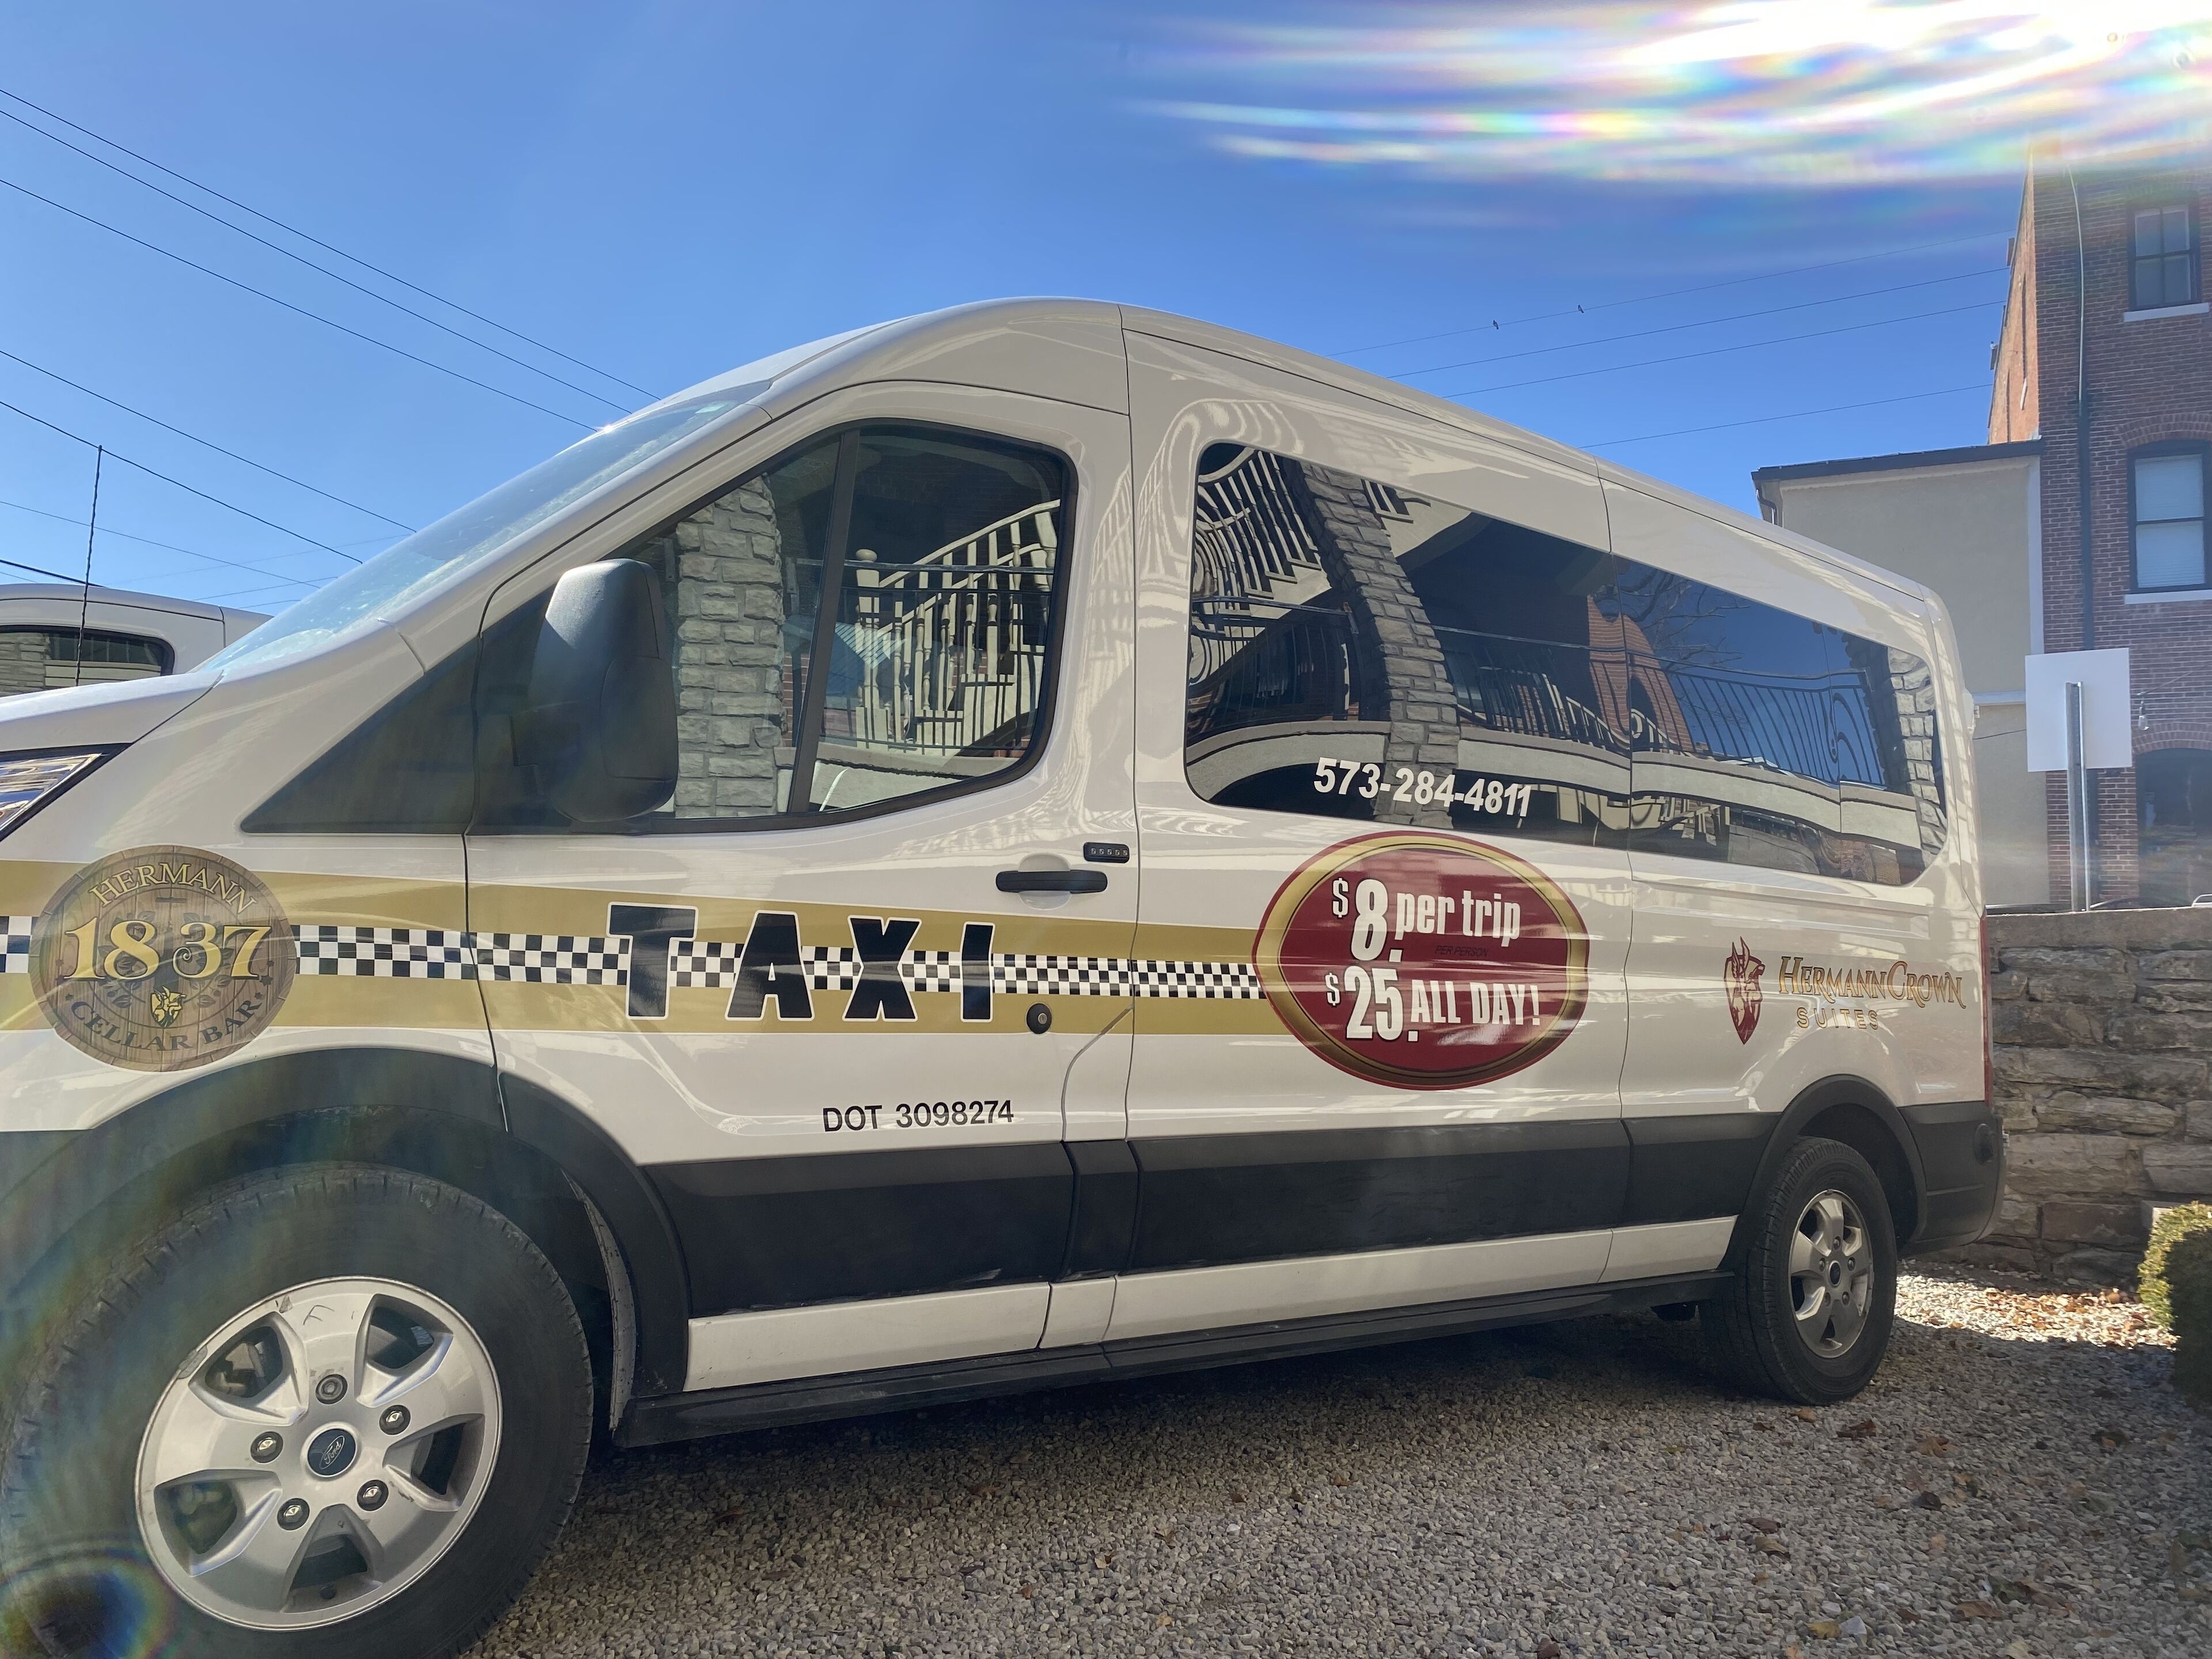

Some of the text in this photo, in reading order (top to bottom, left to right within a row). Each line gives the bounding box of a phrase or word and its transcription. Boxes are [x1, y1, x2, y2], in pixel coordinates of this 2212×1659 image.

[1313, 756, 1532, 817] 573-284-4811
[89, 862, 257, 914] HERMANN
[1394, 892, 1455, 941] per
[1461, 889, 1521, 948] trip
[63, 916, 271, 979] 1837
[606, 902, 996, 1022] TAXI
[1435, 945, 1489, 957] PER PERSON
[70, 999, 263, 1051] CELLAR BAR
[1410, 979, 1461, 1024] ALL
[1469, 982, 1540, 1026] DAY!
[1797, 1006, 1879, 1031] SUITES
[822, 1100, 1014, 1132] DOT 3098274
[323, 1441, 342, 1465] Ford
